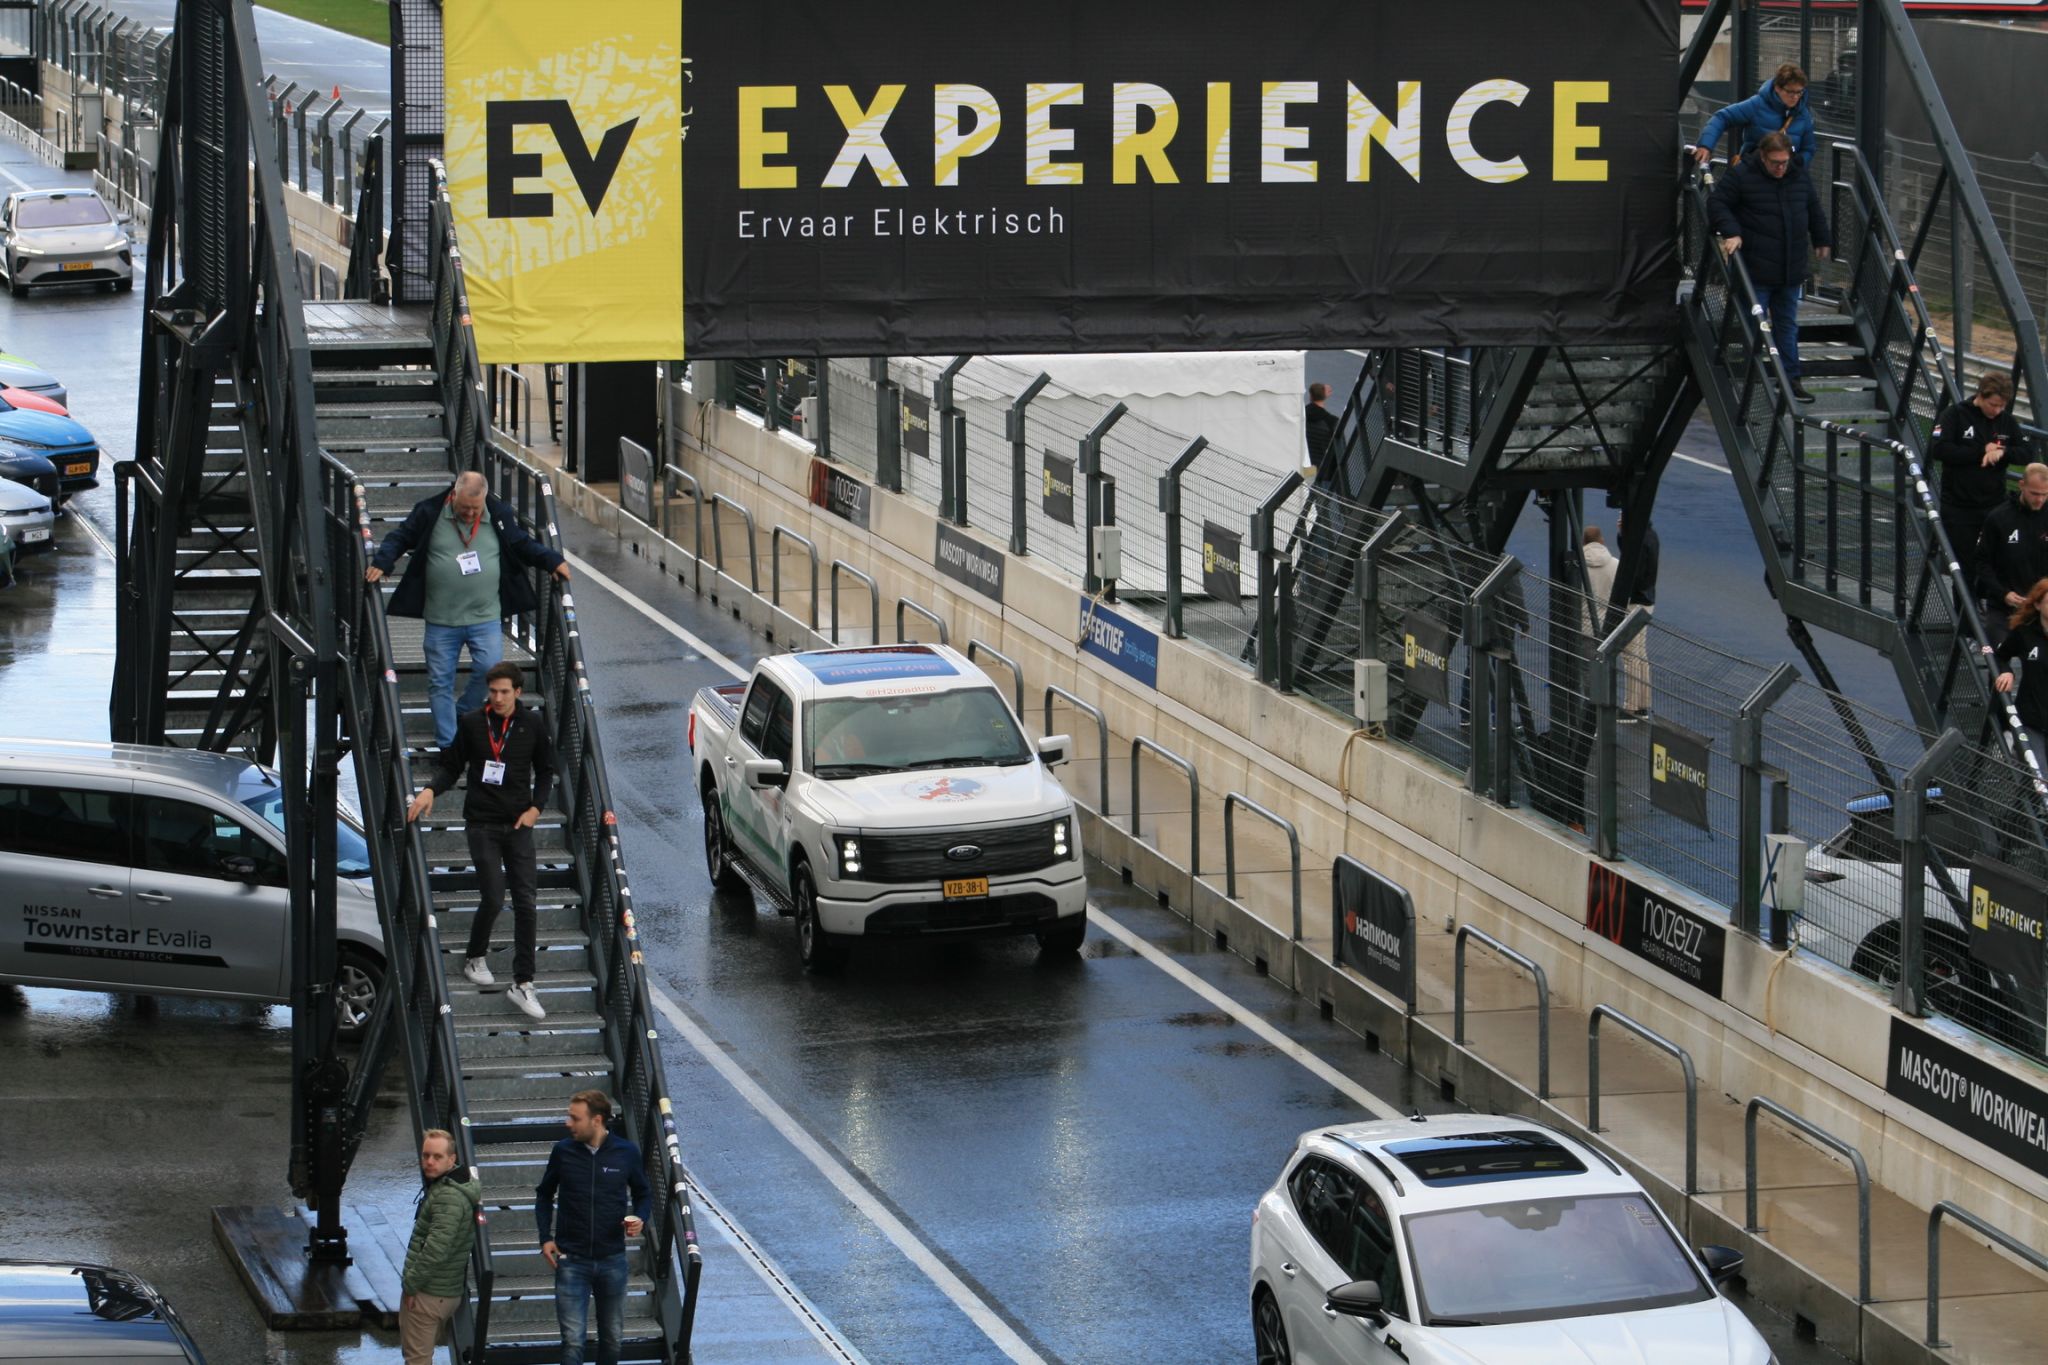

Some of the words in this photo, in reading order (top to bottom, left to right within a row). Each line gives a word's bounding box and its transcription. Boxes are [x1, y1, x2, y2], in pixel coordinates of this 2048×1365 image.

[738, 78, 1609, 189] EXPERIENCE
[486, 99, 639, 218] EV
[738, 209, 854, 239] Ervaar
[873, 206, 1065, 237] Elektrisch
[965, 551, 1000, 587] WORKWEAR
[1415, 644, 1446, 672] EXPERIENCE
[1666, 756, 1706, 789] EXPERIENCE
[23, 904, 81, 919] NISSAN
[1976, 896, 1986, 916] EV
[1989, 900, 2043, 941] EXPERIENCE
[23, 917, 141, 944] Townstar
[146, 928, 212, 949] Evalia
[1355, 916, 1400, 959] Hankook
[69, 946, 99, 956] 100%
[104, 949, 173, 961] ELEKTRISCH
[1367, 945, 1383, 965] driving
[1382, 955, 1401, 973] emotion
[1641, 937, 1665, 962] HEARING
[1665, 950, 1702, 981] PROTECTION
[1970, 1081, 2048, 1154] WORKWEA
